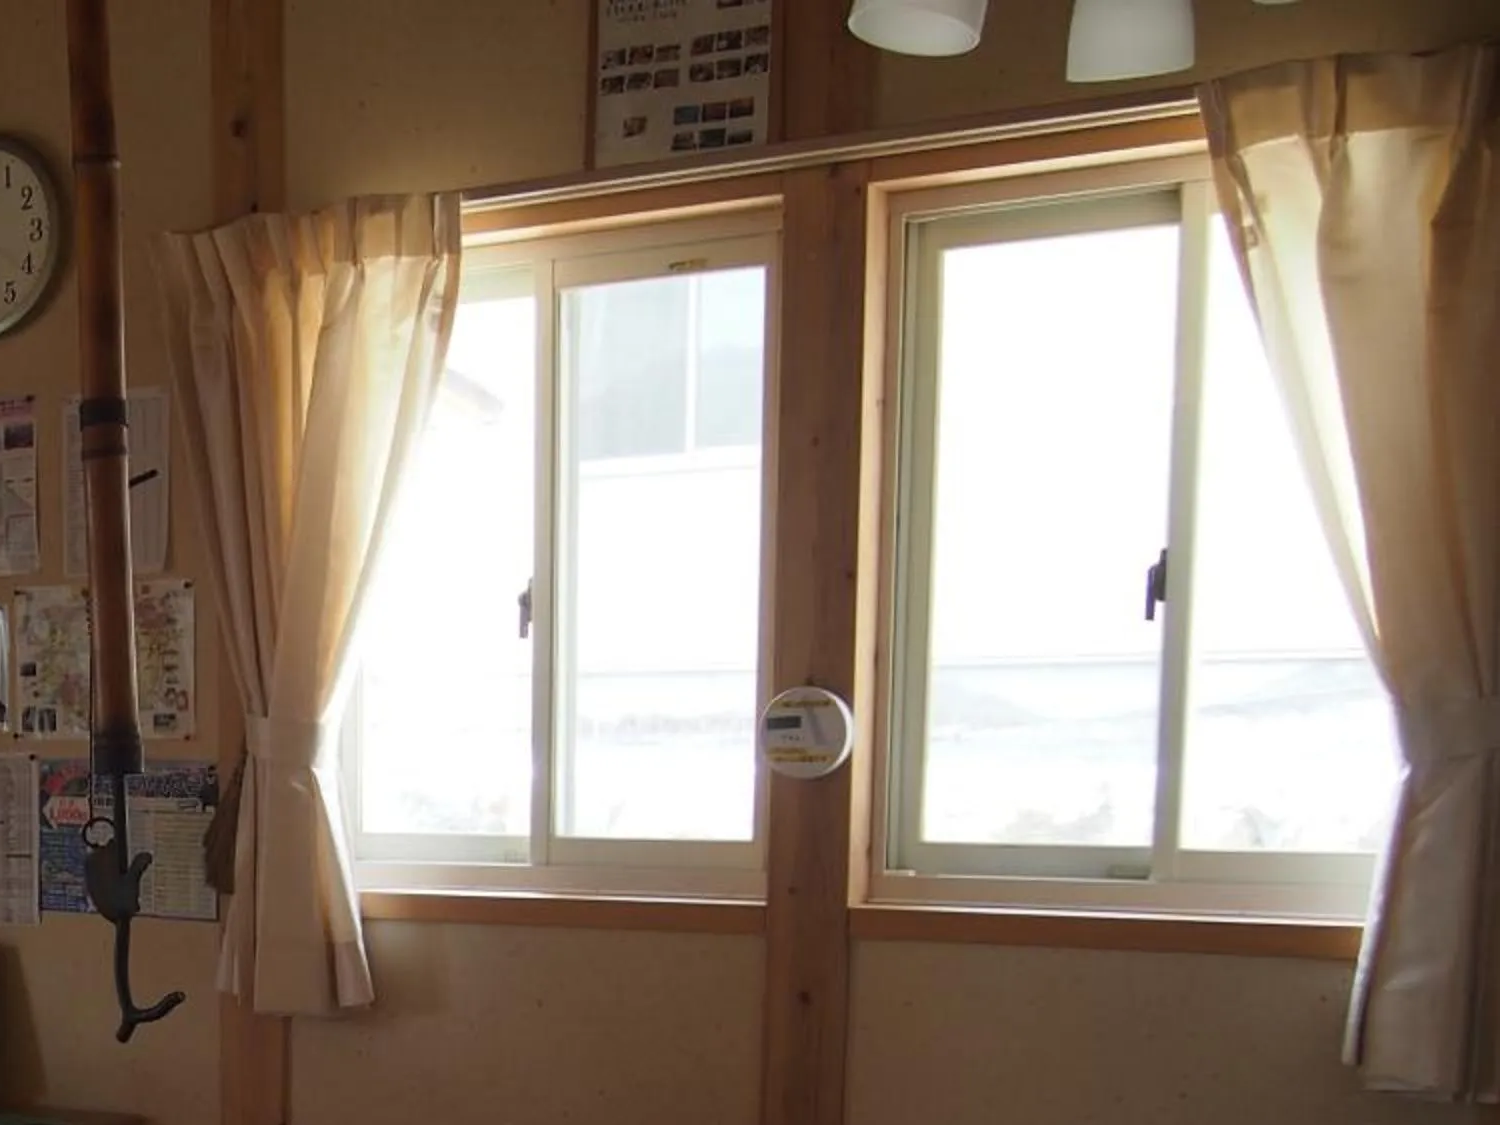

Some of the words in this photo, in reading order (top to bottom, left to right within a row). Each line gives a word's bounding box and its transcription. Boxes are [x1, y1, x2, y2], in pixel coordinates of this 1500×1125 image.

[20, 186, 34, 210] 2
[29, 217, 43, 242] 3
[21, 252, 34, 275] 4
[3, 281, 16, 304] 5
